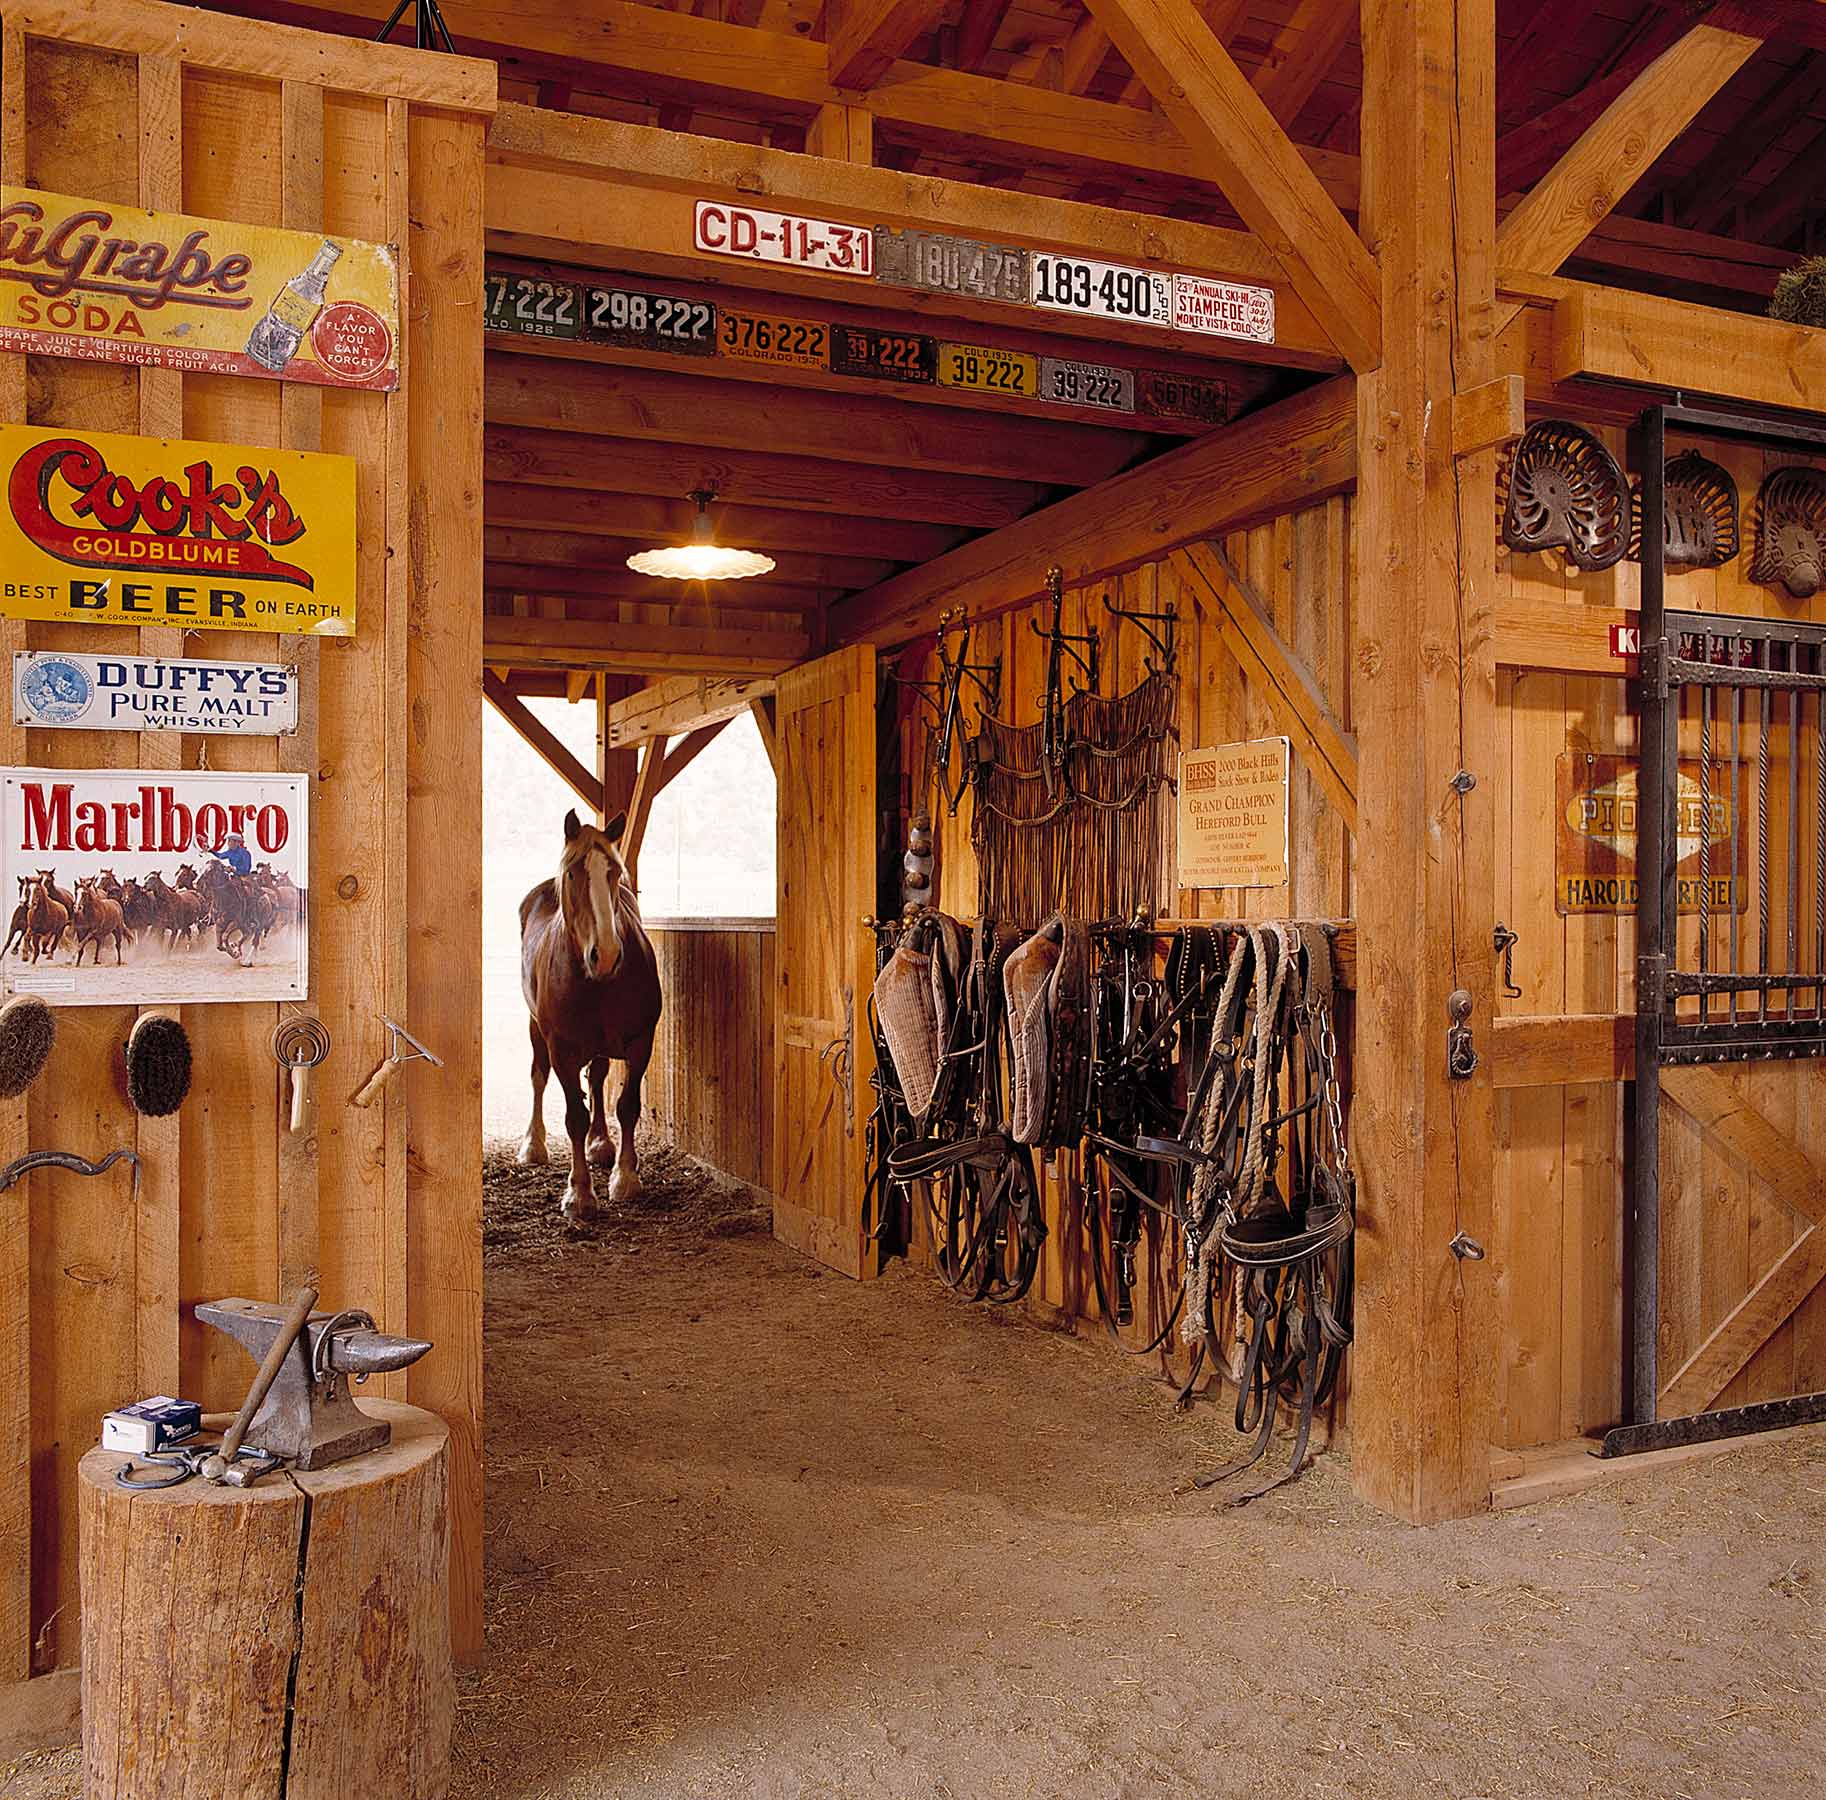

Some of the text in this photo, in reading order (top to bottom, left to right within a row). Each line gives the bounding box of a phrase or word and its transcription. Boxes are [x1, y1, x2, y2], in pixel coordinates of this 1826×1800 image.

[699, 206, 869, 273] CD-11-31
[1193, 284, 1223, 300] ANNUAL
[17, 295, 146, 338] SODA
[347, 313, 355, 321] A
[1152, 308, 1169, 320] 22
[1176, 313, 1204, 326] MONTE
[1179, 295, 1245, 321] STAMPEDE
[326, 321, 376, 335] FLAVOR
[337, 333, 364, 345] YOU
[20, 342, 71, 355] FLAVOR
[78, 348, 113, 360] CANE
[119, 353, 162, 365] SUGAR
[168, 358, 204, 369] FRUIT
[209, 363, 238, 372] ACID
[47, 336, 86, 347] JUICE
[166, 349, 209, 361] COLOR
[327, 354, 376, 367] FORGET
[334, 344, 370, 356] CAN'T
[728, 347, 793, 362] COLORADO
[8, 438, 308, 550] Cook's
[73, 535, 240, 565] GOLDBLUME
[4, 580, 341, 619] BEST BEER ON EARTH
[96, 661, 288, 695] DUFFY'S
[111, 692, 274, 719] PURE MALT
[144, 714, 246, 729] WHISKEY
[1187, 762, 1215, 780] BHSS
[1260, 753, 1279, 767] Hills
[1189, 793, 1276, 814] GRAND CHAMPION
[1578, 798, 1728, 833] PIOER
[20, 783, 289, 854] Marlboro
[1195, 812, 1268, 830] HEREFORD BULL
[1566, 878, 1639, 905] HAROLD
